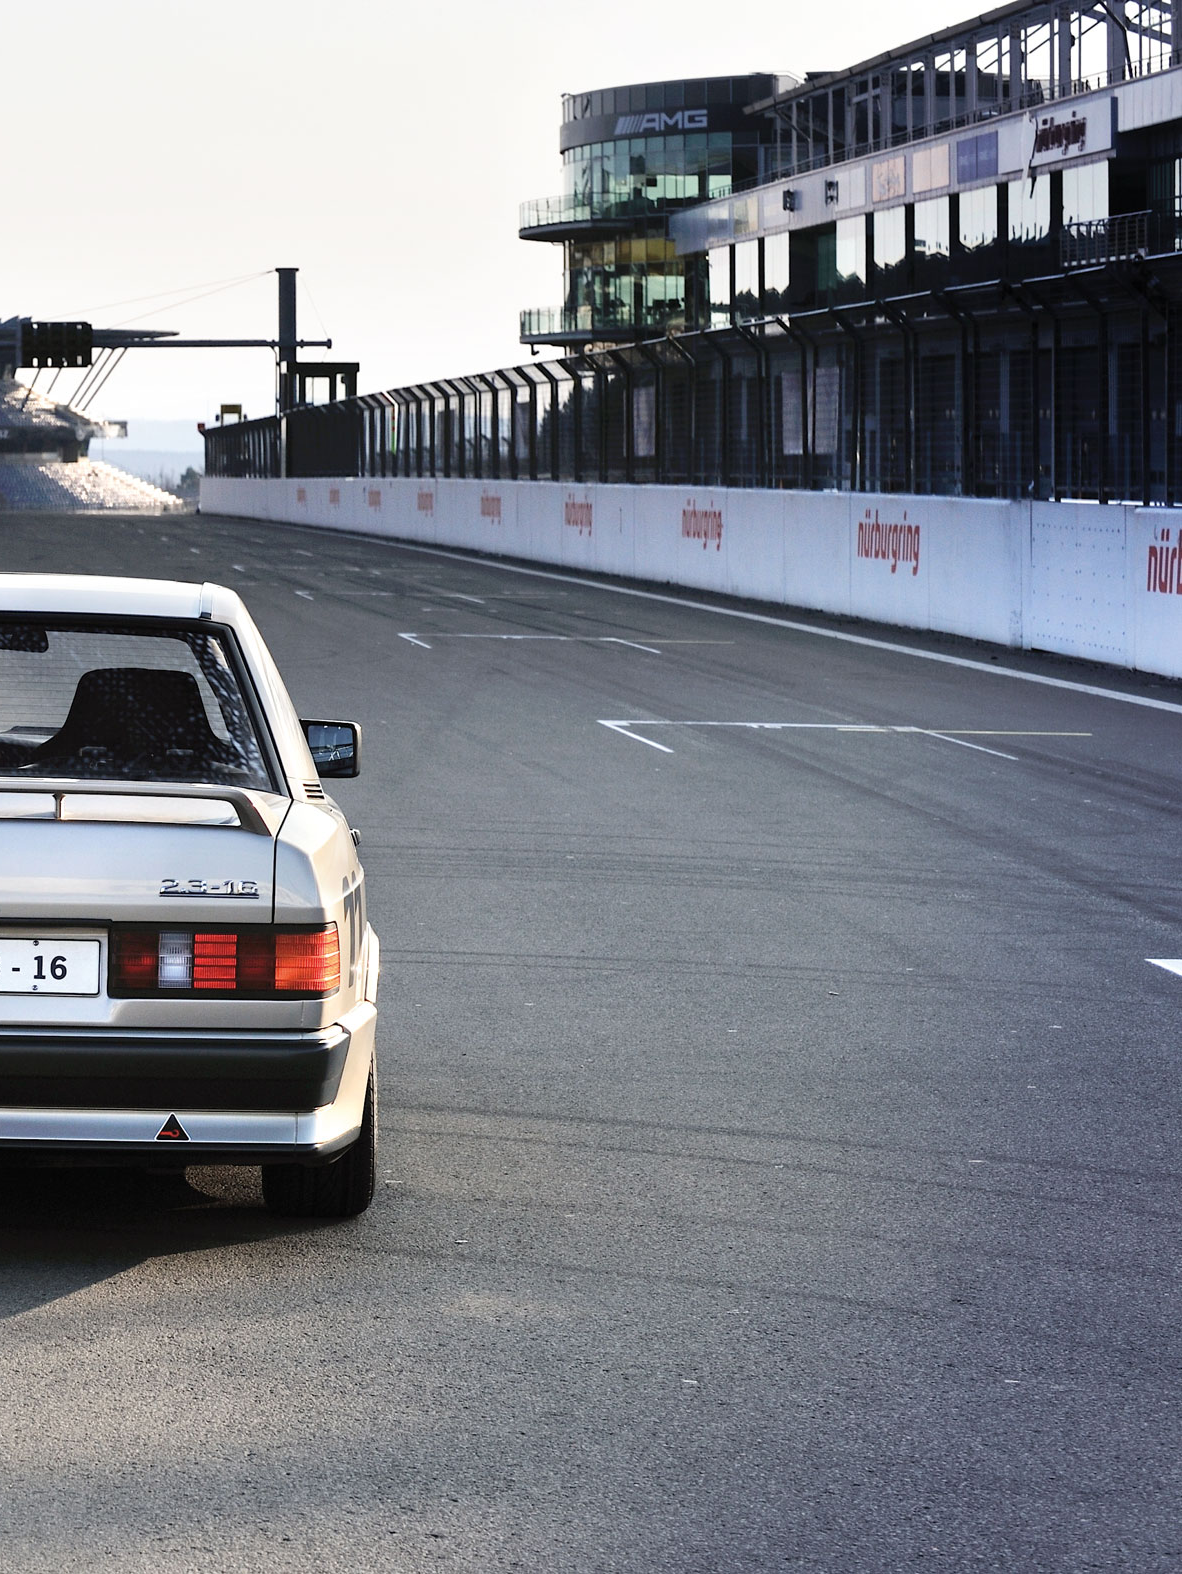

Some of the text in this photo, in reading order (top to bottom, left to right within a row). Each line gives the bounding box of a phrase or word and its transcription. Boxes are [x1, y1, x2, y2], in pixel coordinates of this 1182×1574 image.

[639, 109, 708, 133] AMG
[858, 508, 920, 576] nürburgring
[159, 879, 258, 895] 2.3-16
[33, 955, 67, 980] 16
